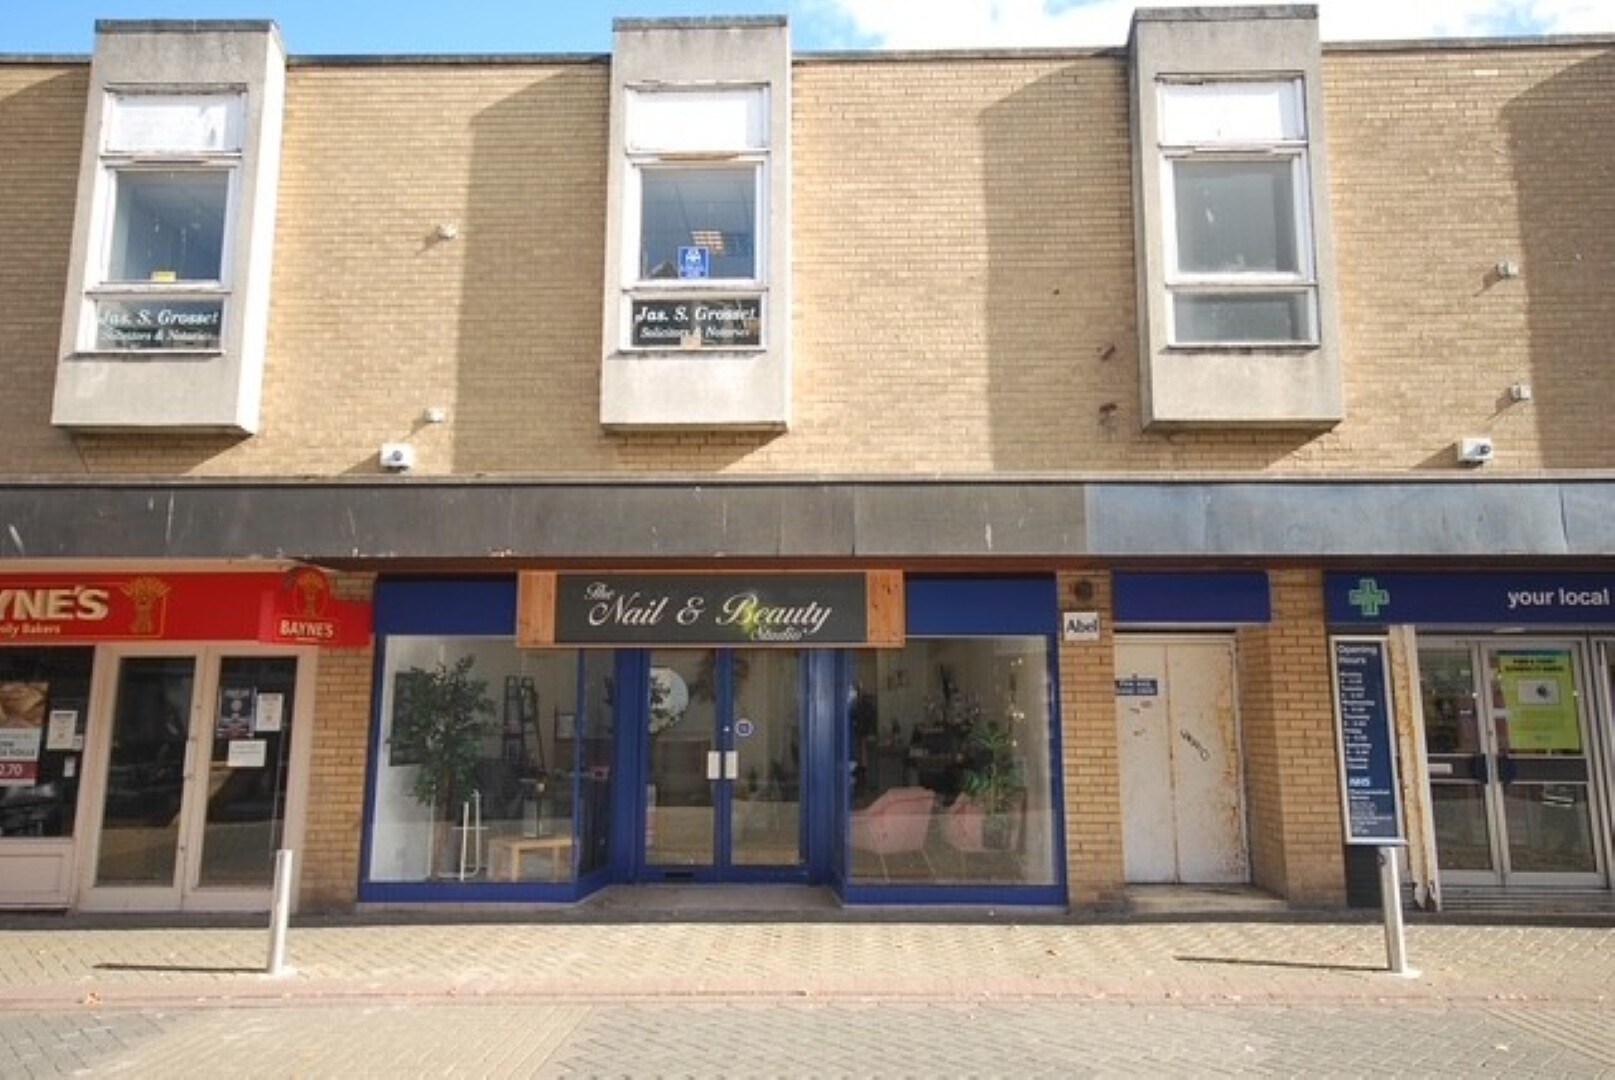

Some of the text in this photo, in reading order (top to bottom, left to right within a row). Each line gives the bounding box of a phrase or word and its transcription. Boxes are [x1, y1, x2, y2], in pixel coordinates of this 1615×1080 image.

[585, 581, 615, 600] The
[1507, 587, 1610, 610] your local
[588, 591, 832, 633] Nail & Beauty
